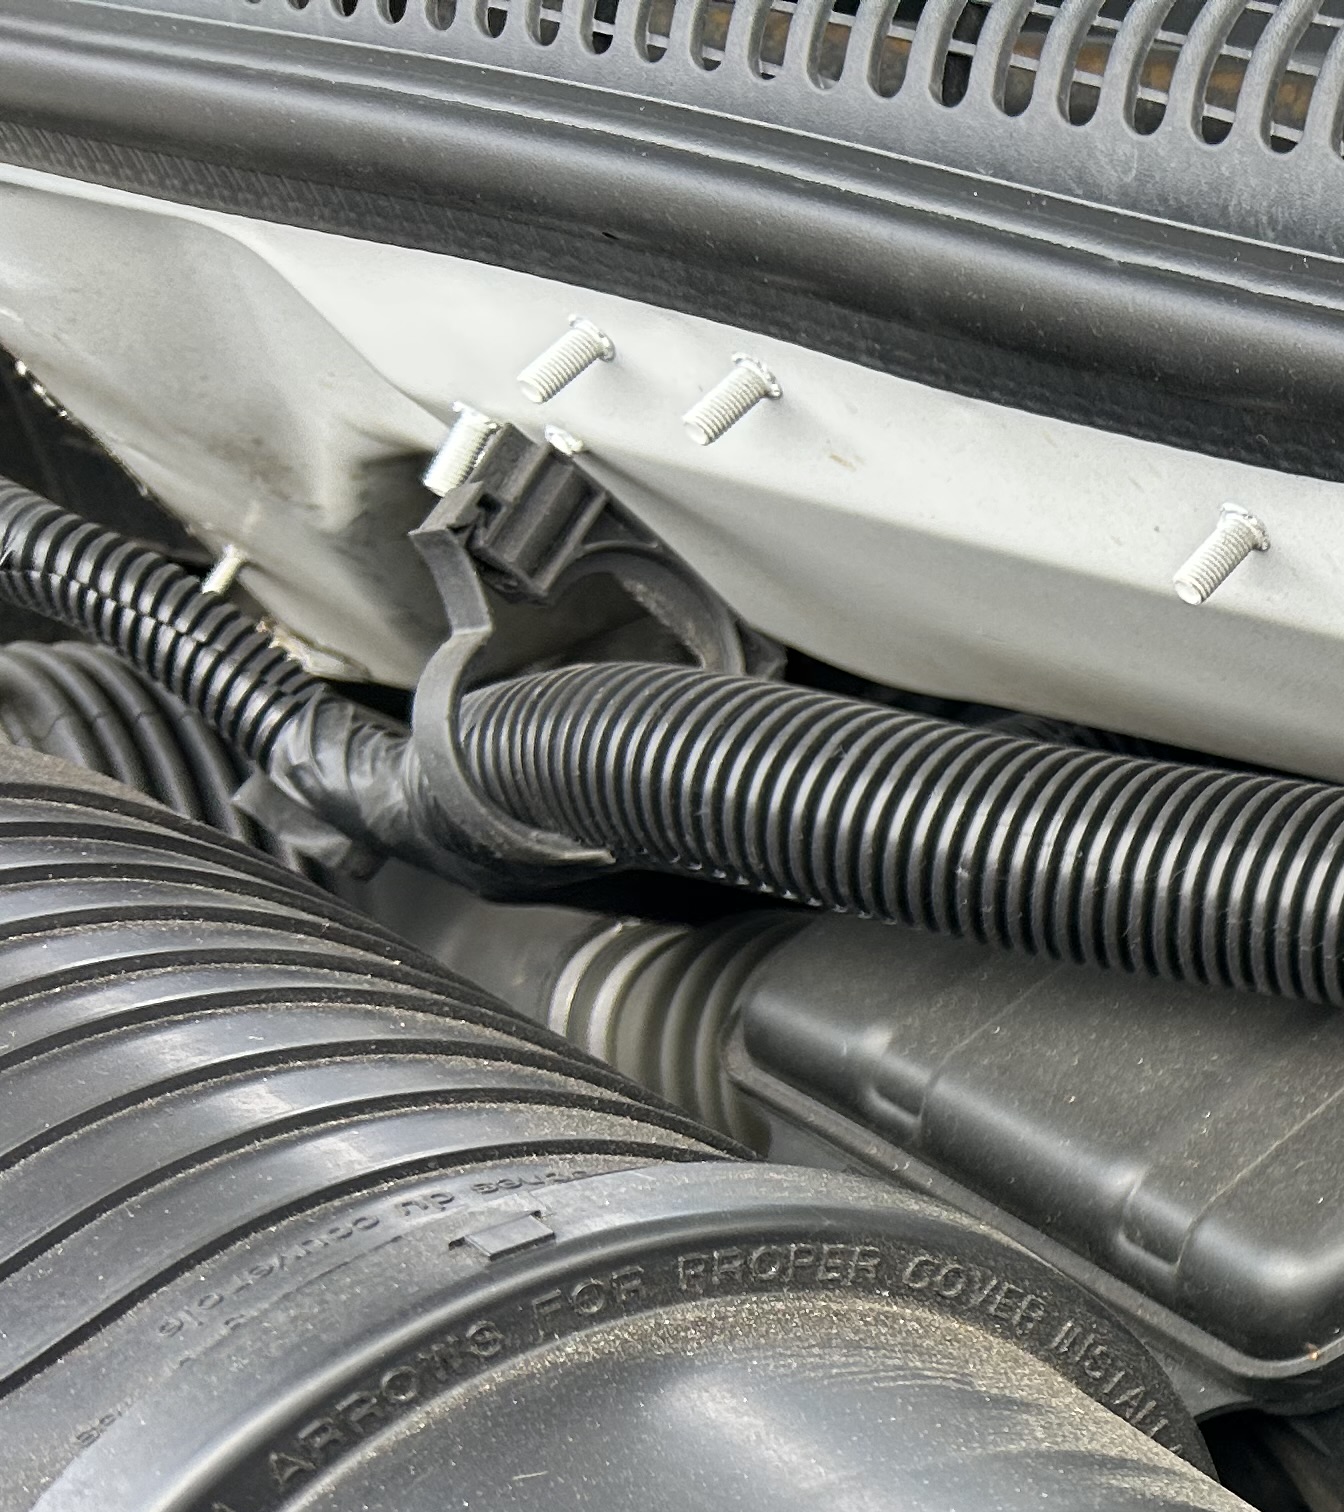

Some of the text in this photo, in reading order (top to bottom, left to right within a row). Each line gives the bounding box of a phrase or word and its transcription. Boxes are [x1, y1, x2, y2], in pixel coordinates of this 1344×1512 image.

[266, 1319, 504, 1487] ARROWS
[532, 1265, 646, 1337] FOR
[676, 1242, 882, 1292] PROPER
[901, 1255, 1052, 1336] COVER
